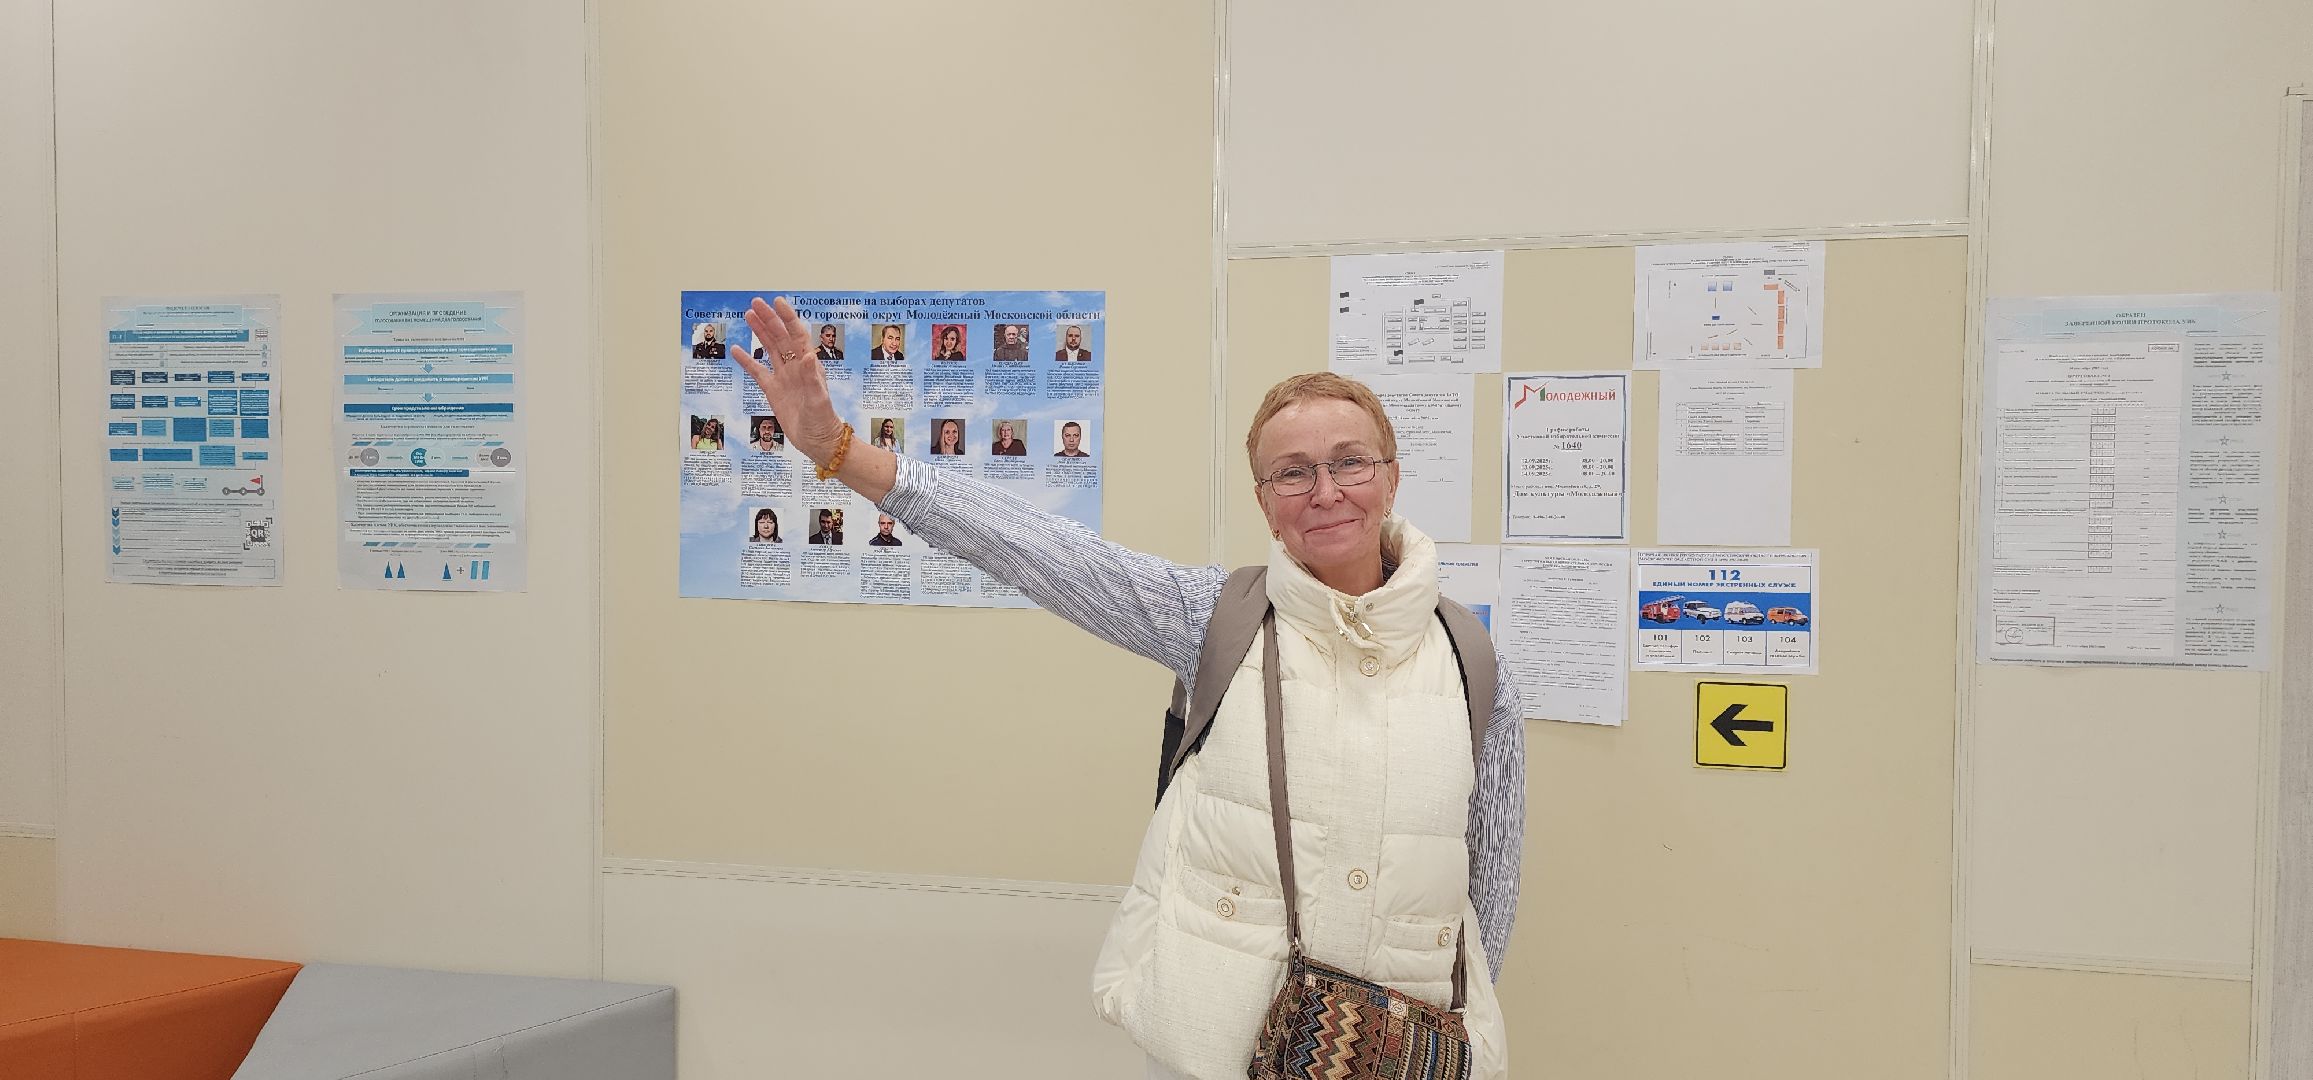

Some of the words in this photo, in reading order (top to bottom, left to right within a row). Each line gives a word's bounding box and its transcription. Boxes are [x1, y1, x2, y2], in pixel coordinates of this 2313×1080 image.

[793, 295, 862, 306] Голосование
[880, 296, 926, 308] выборах
[929, 299, 986, 308] депутатов
[685, 309, 722, 319] Совета
[795, 309, 812, 320] ТО
[814, 310, 869, 321] городской
[872, 311, 904, 321] округ
[906, 309, 981, 321] Молодёжный
[983, 309, 1053, 320] Московской
[1056, 310, 1101, 320] области
[1561, 441, 1583, 450] 1640
[251, 529, 264, 538] QR
[1708, 569, 1741, 581] 112
[1695, 634, 1711, 642] 102
[1737, 635, 1753, 643] 103
